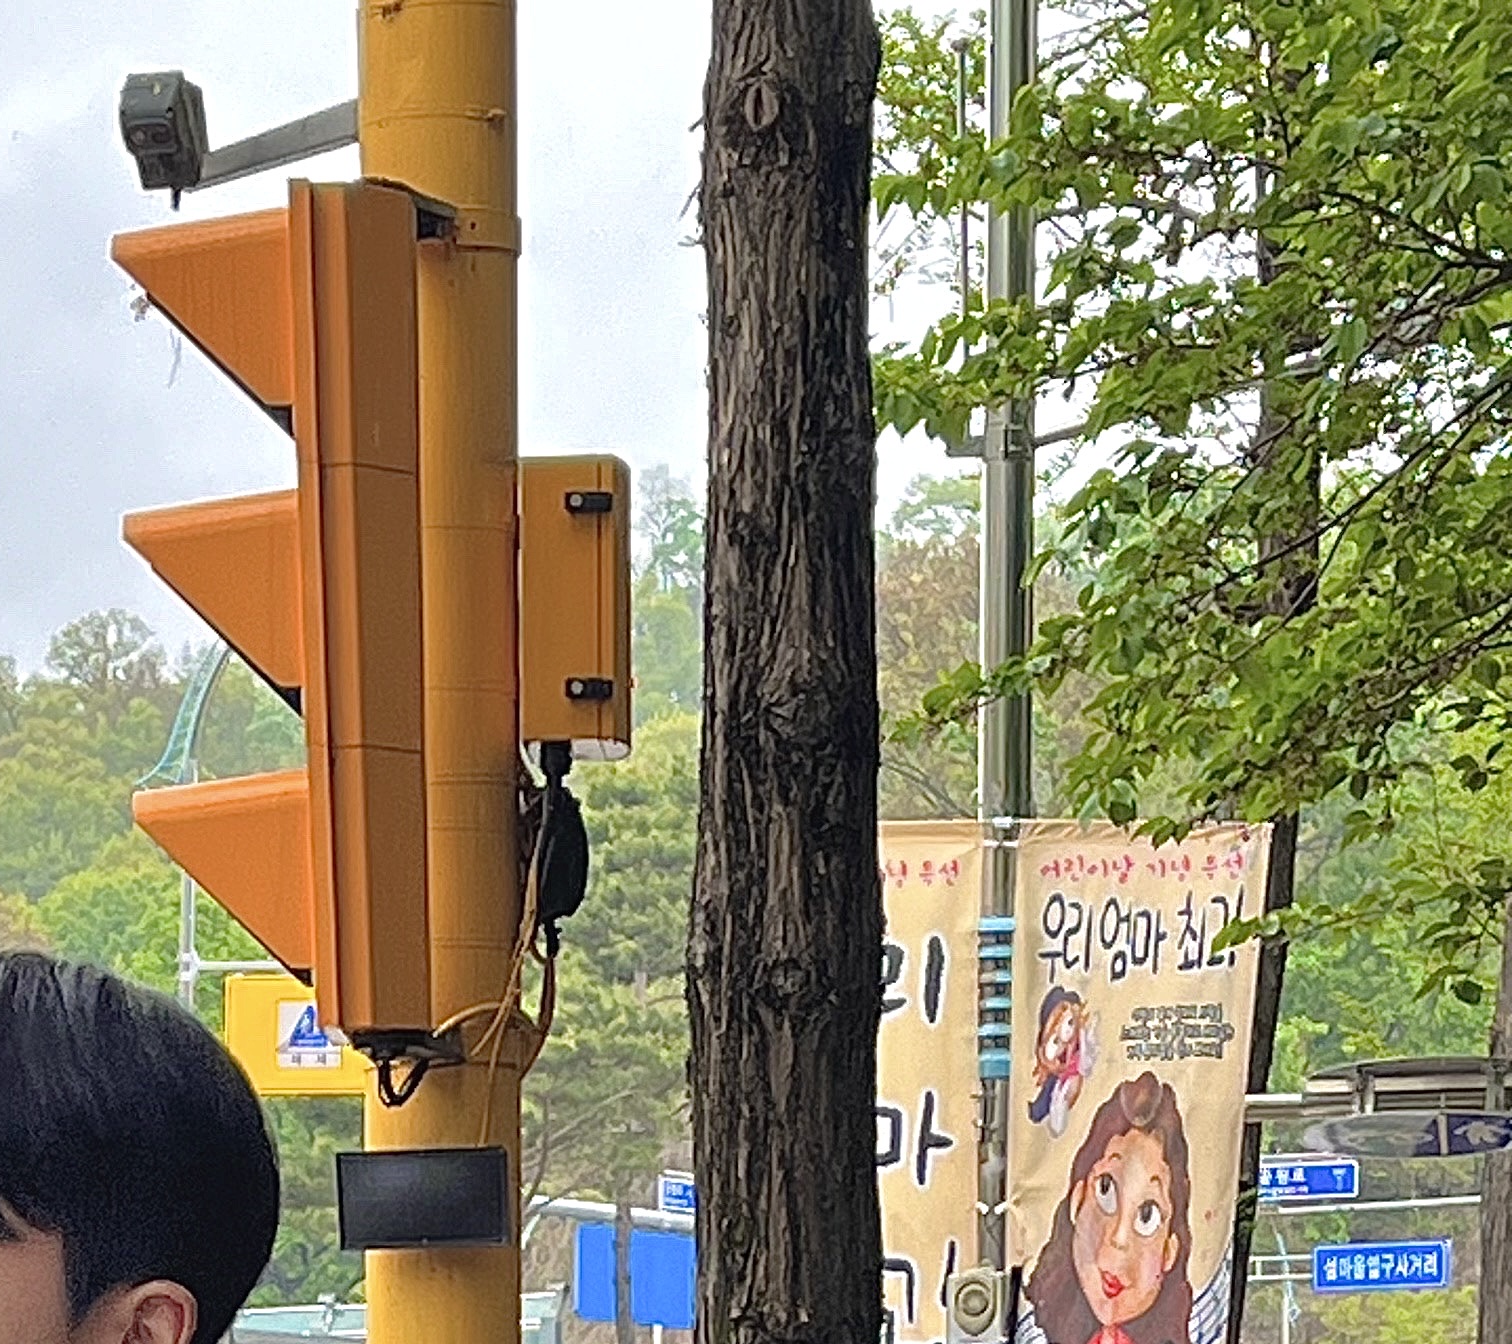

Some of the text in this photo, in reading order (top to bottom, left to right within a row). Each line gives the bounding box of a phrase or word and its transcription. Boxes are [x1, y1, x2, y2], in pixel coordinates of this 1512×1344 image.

[1040, 853, 1135, 885] 어린이날
[1038, 891, 1093, 984] 우리
[1099, 897, 1169, 982] 엄마
